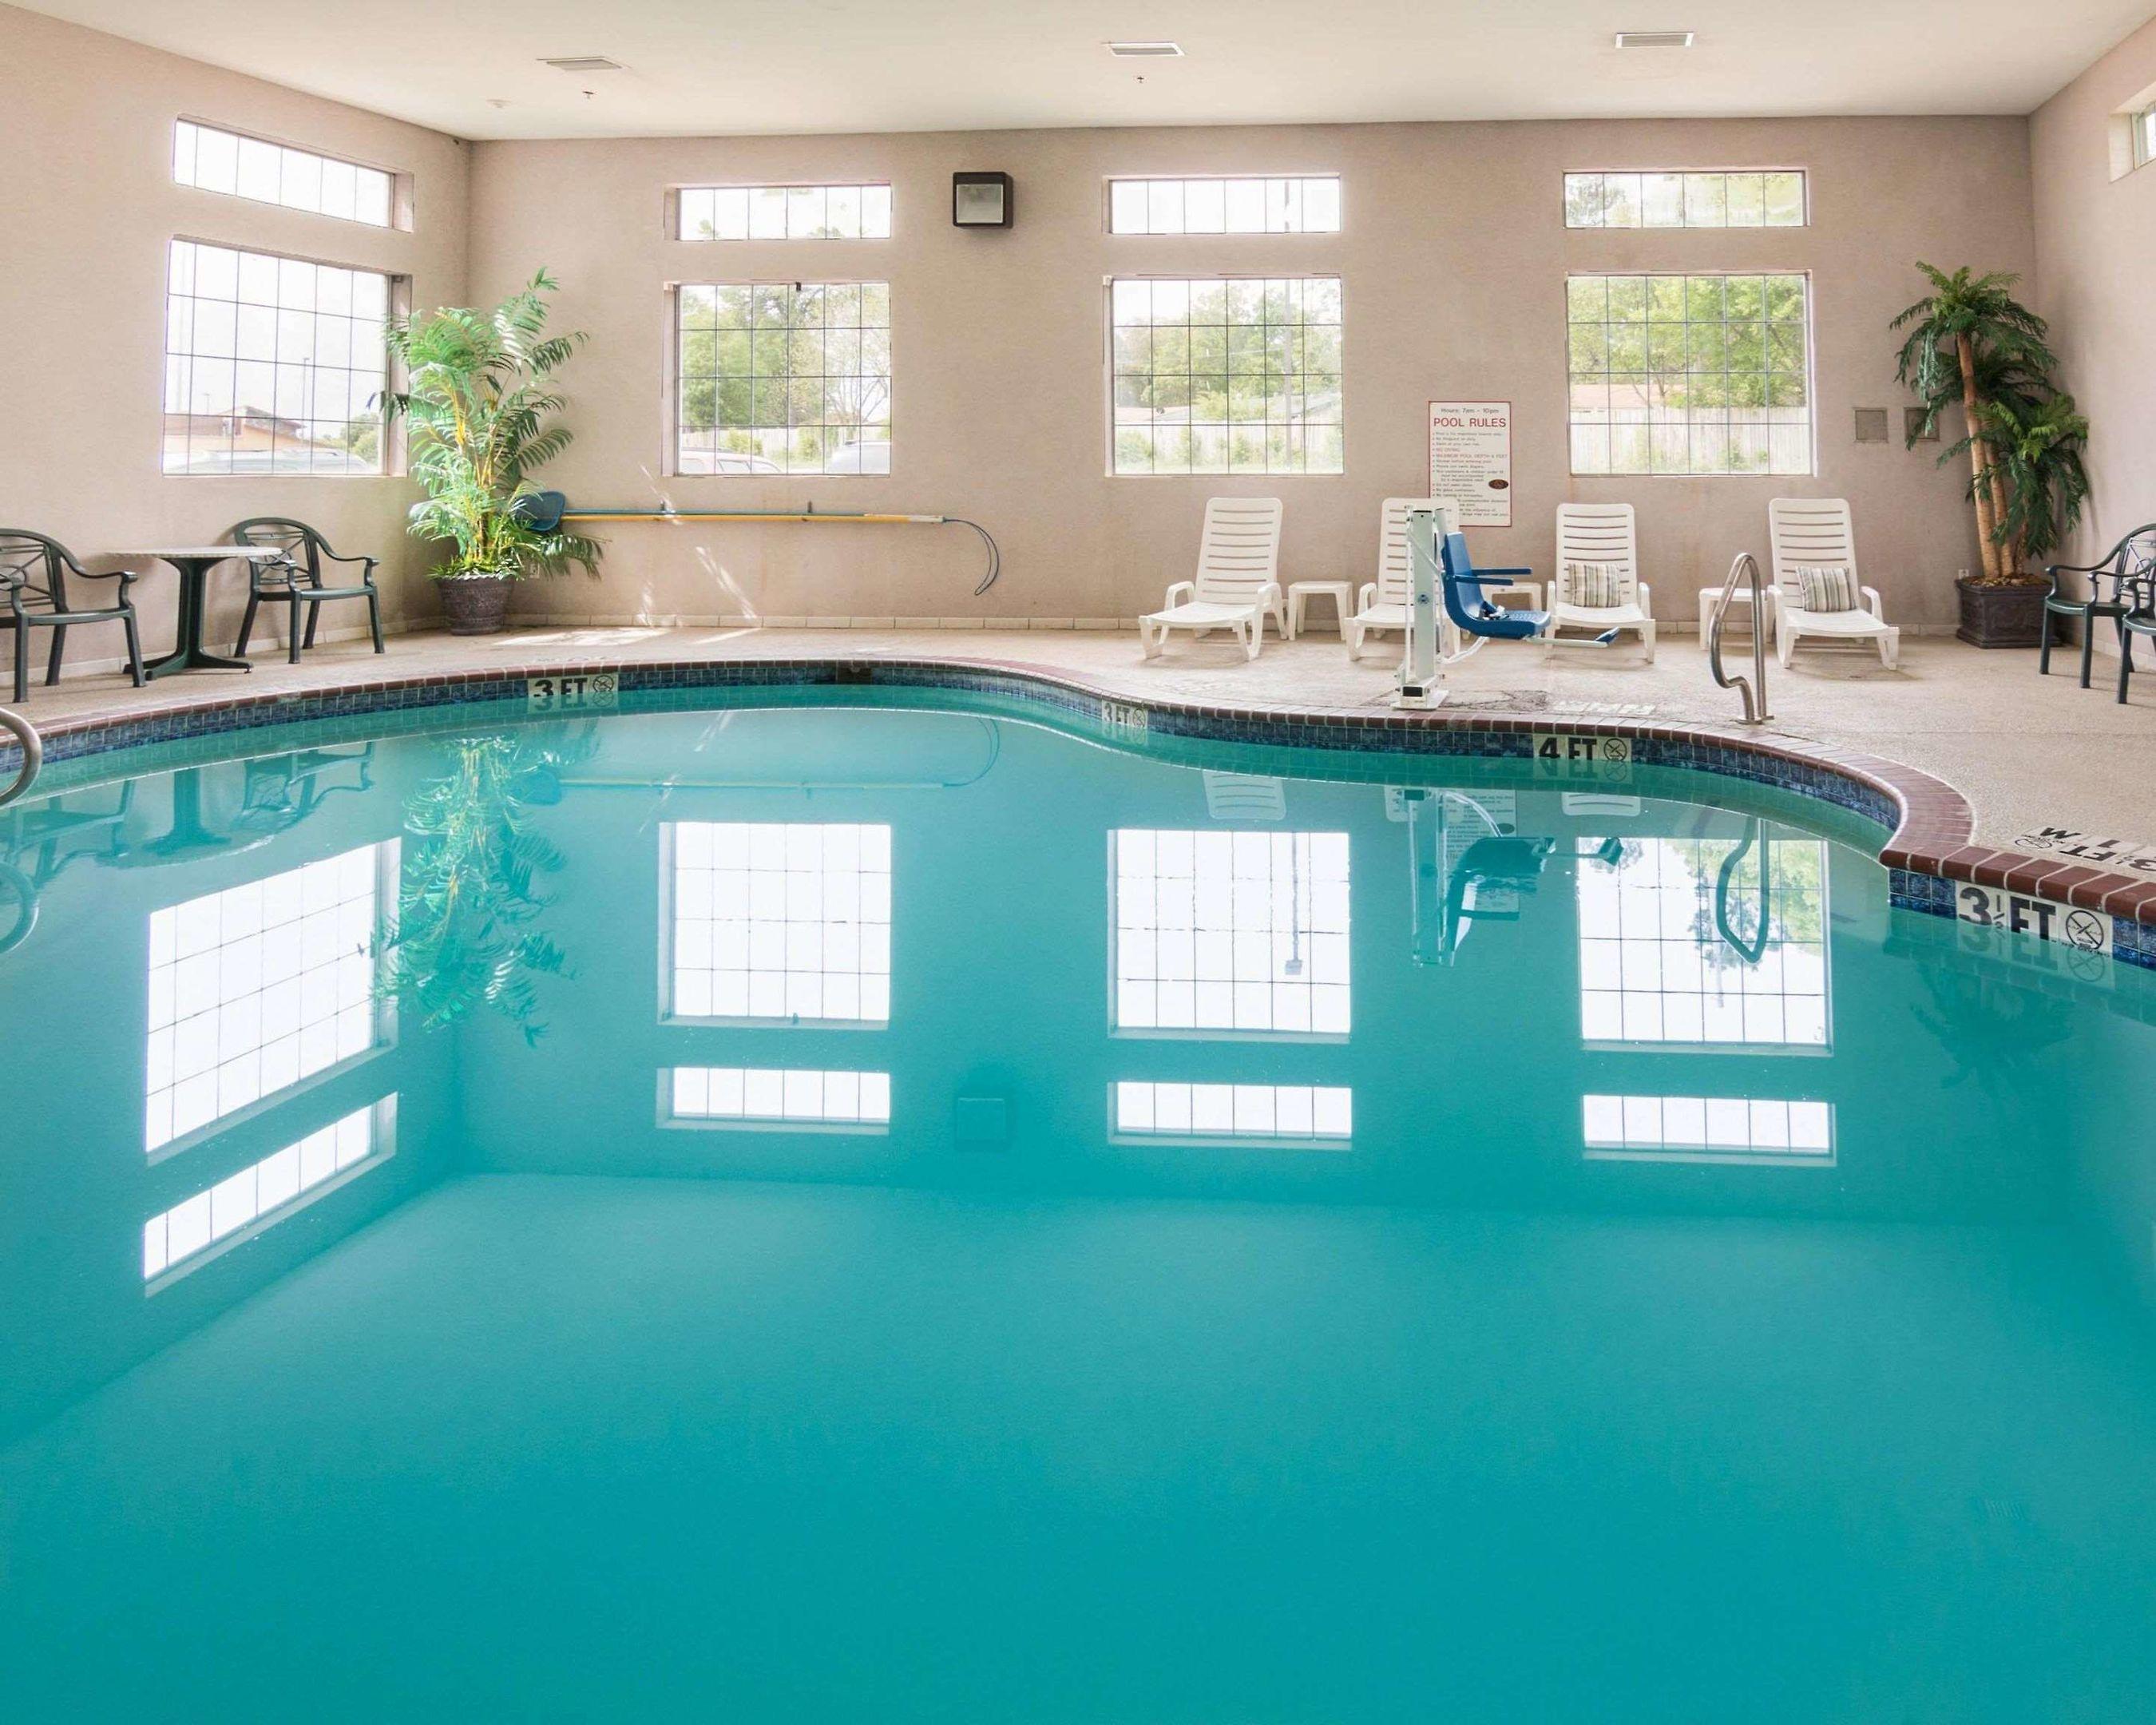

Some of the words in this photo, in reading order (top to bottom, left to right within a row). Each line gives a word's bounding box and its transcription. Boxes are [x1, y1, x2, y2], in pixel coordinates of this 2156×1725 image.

[1433, 418, 1464, 427] POOL
[1469, 418, 1507, 427] RULES
[533, 679, 554, 698] 3
[561, 677, 589, 696] FT
[1116, 705, 1130, 724] FT
[1539, 737, 1561, 759] 4
[1568, 737, 1597, 761] FT
[2010, 896, 2057, 941] FT
